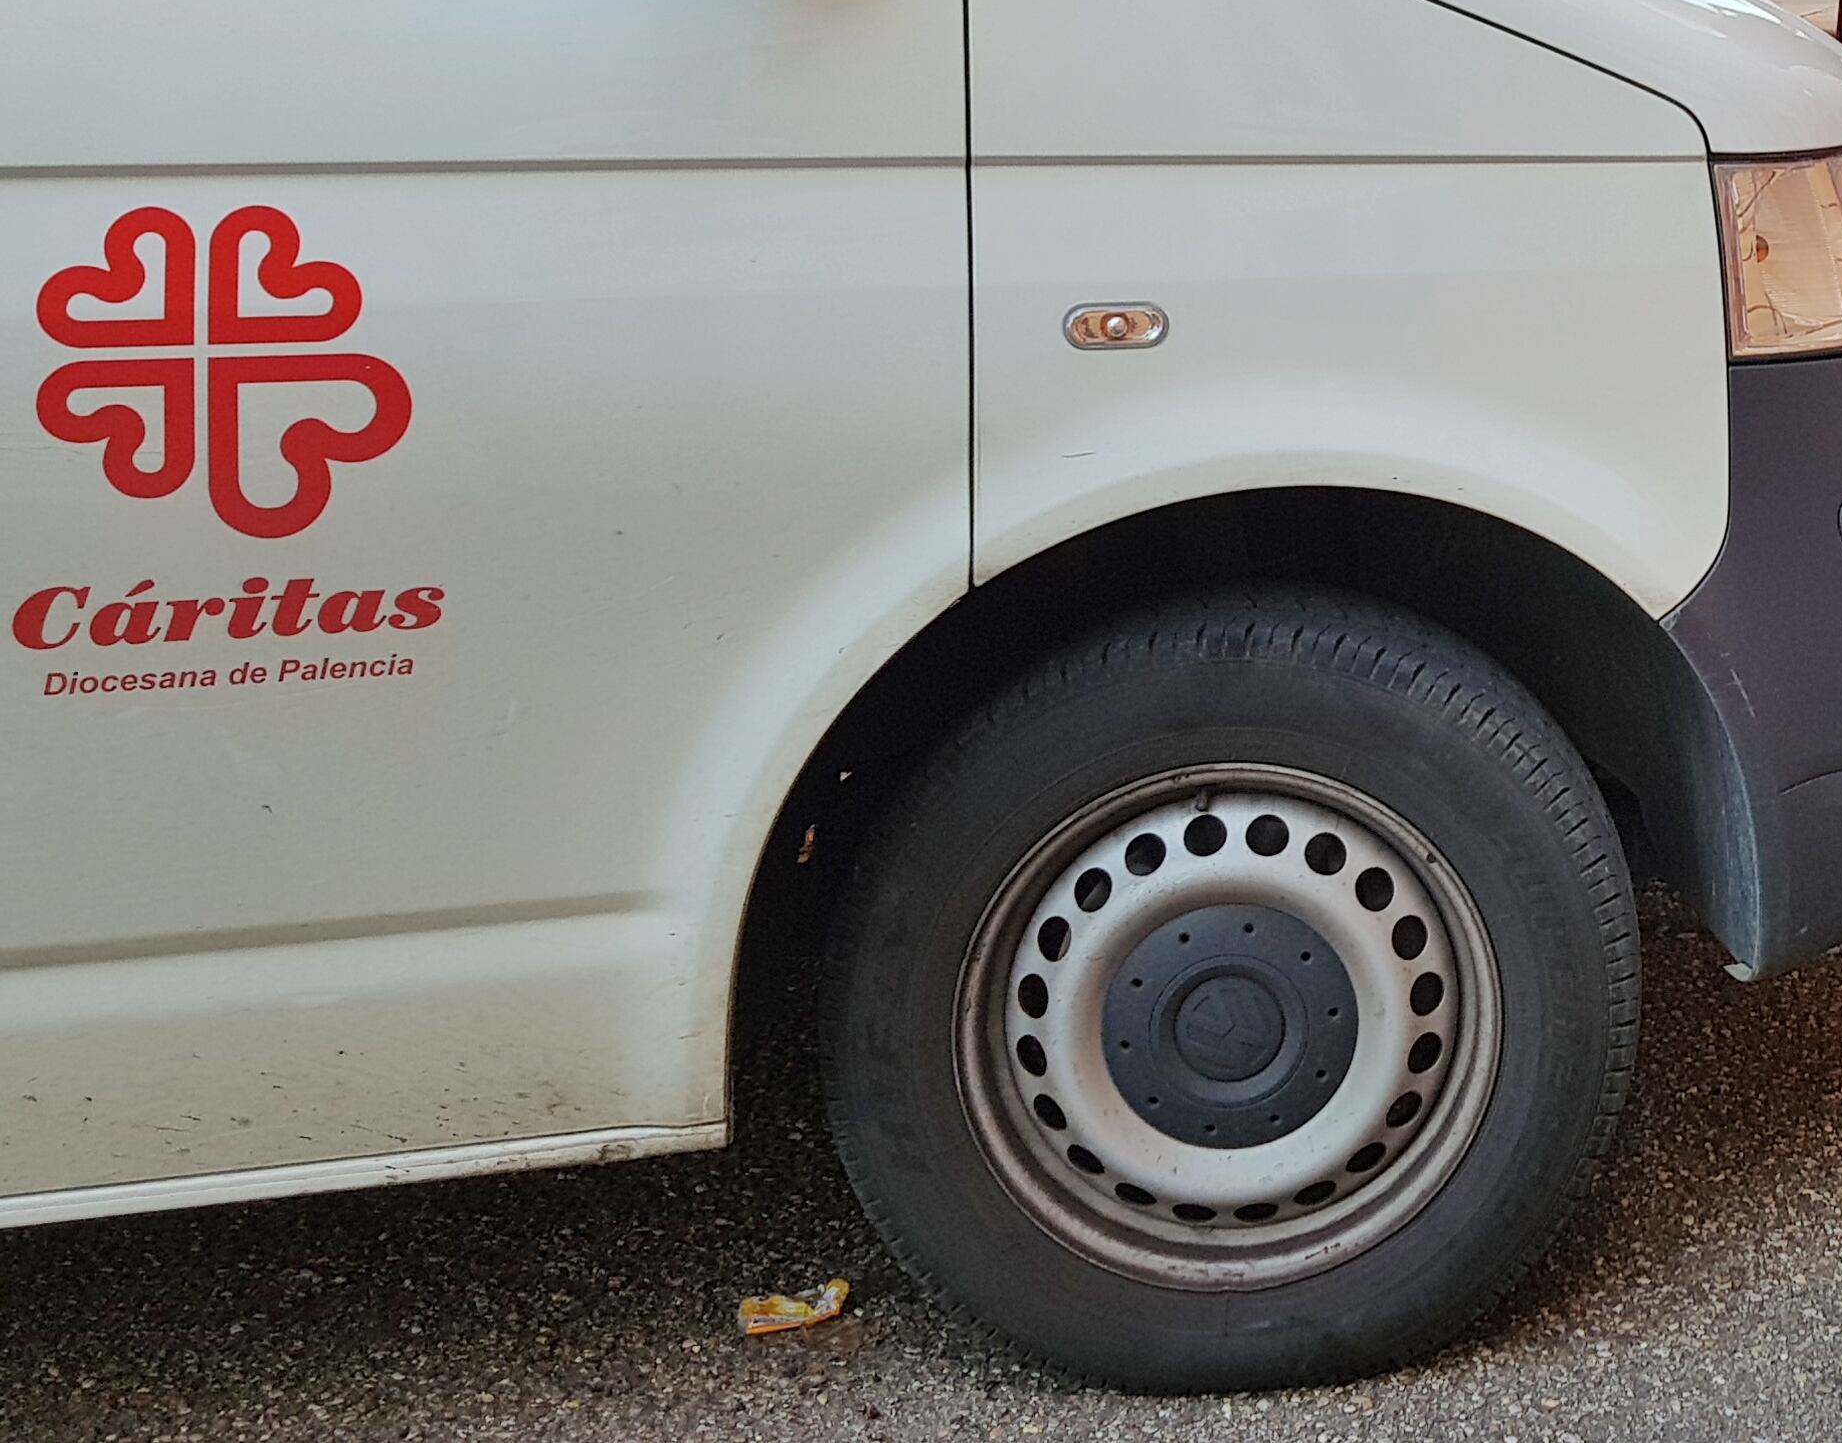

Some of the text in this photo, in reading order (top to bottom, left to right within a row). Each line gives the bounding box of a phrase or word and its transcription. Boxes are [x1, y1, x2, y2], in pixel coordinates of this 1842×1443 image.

[11, 576, 446, 651] Cáritas
[43, 654, 416, 697] Diocesana de Palencia
